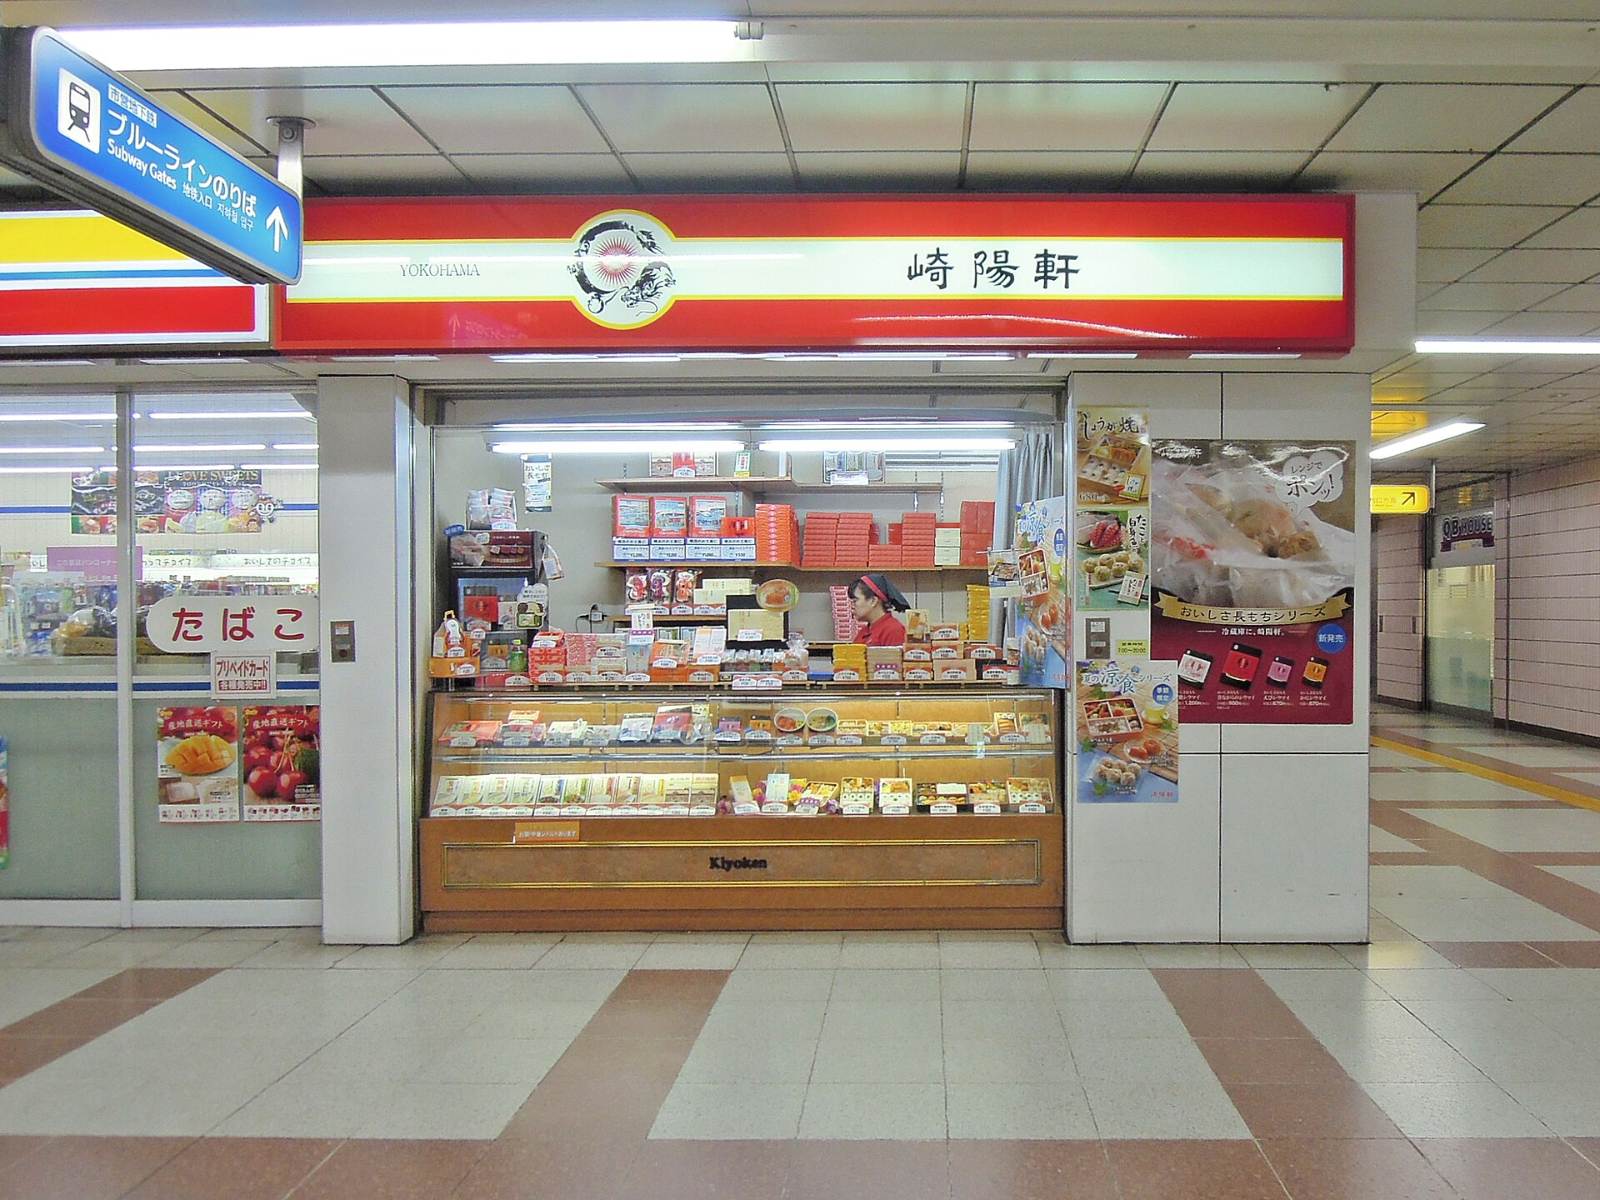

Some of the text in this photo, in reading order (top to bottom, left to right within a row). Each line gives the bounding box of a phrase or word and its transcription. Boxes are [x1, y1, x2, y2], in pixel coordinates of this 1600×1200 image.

[107, 109, 257, 217] ブルーラインのりば
[107, 138, 177, 189] Subway Gates
[400, 262, 480, 277] YOKOHAMA
[907, 246, 1081, 290] 崎陽軒
[1291, 462, 1323, 473] レンジで
[1460, 515, 1493, 535] HOUSE
[1180, 606, 1327, 623] おいしさ長もちシリーズ
[171, 606, 305, 642] たばこ
[1318, 633, 1345, 644] 新発売
[216, 660, 269, 677] プリペイドカード
[168, 718, 224, 730] 産地直送ギフト
[252, 718, 309, 729] 産地直送ギフト
